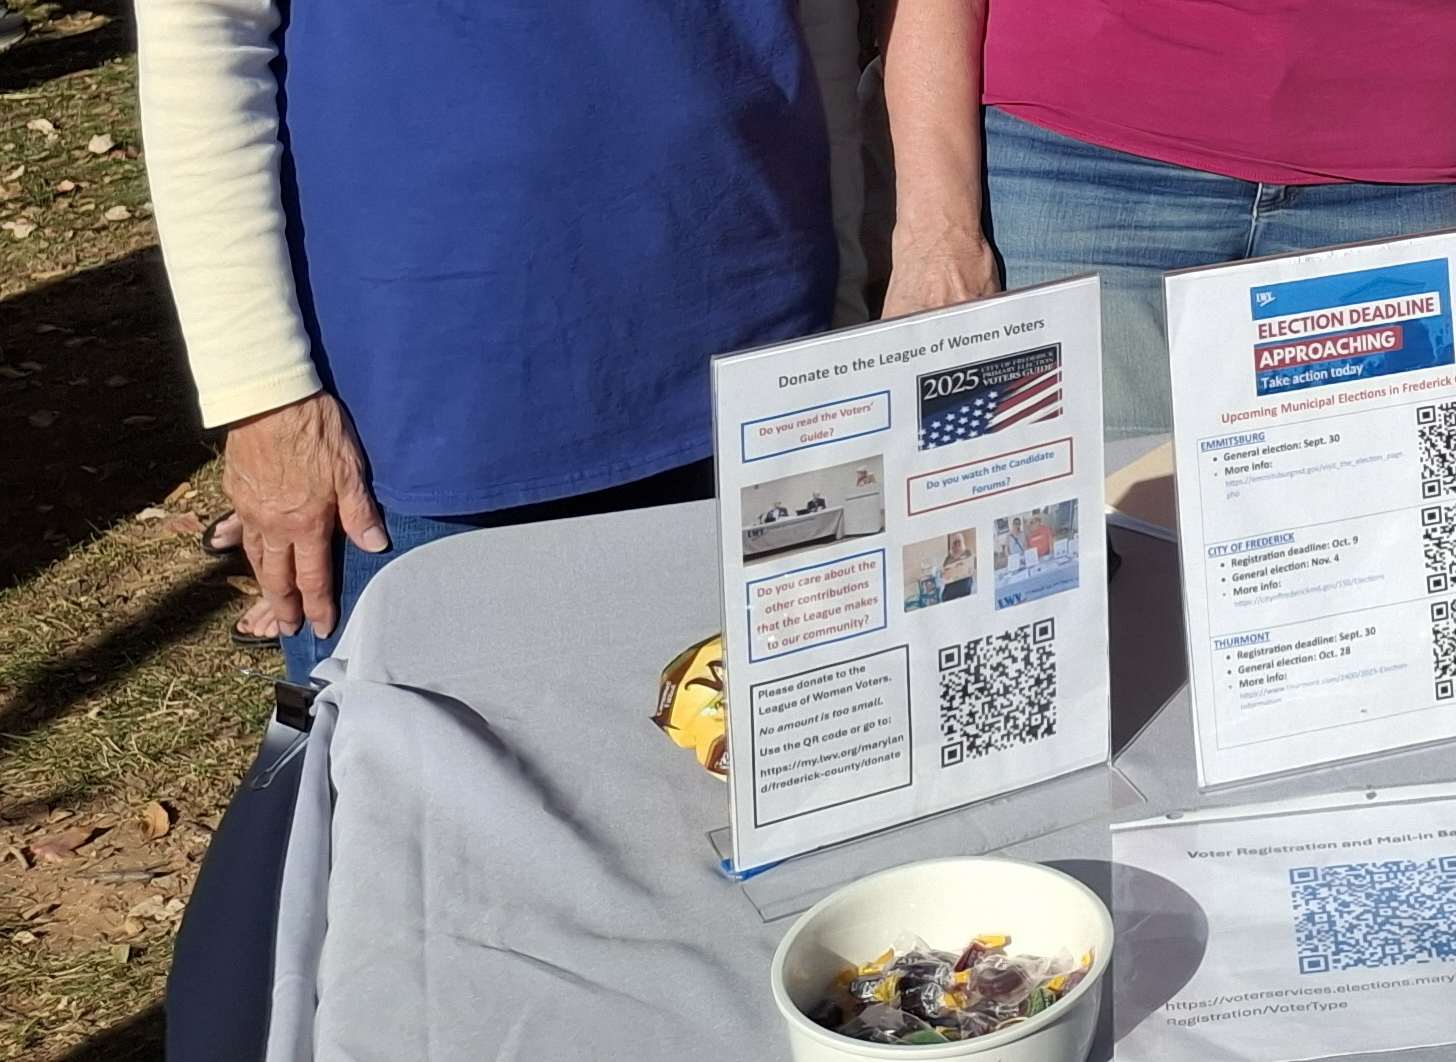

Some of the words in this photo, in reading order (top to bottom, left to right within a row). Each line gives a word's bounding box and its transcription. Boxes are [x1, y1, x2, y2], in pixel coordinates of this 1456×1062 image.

[1257, 311, 1343, 339] ELECTION
[1348, 296, 1434, 324] DEADLINE
[778, 368, 829, 388] Donate
[833, 364, 847, 375] to
[852, 357, 874, 371] the
[879, 346, 926, 365] League
[930, 338, 944, 353] of
[947, 330, 999, 348] Women
[1003, 319, 1044, 336] Voters
[1259, 331, 1395, 367] APPROACHING
[923, 369, 979, 400] 2025
[1260, 375, 1290, 388] Take
[1292, 369, 1328, 384] action
[1330, 364, 1363, 377] today
[1221, 406, 1277, 424] Upcoming
[1280, 394, 1334, 413] Municipal
[1338, 388, 1386, 403] Elections
[1389, 385, 1399, 394] in
[1402, 376, 1451, 392] Frederick
[759, 427, 773, 436] Do
[775, 422, 793, 434] you
[796, 414, 818, 427] read
[820, 412, 837, 421] the
[799, 427, 836, 442] Guide?
[1200, 431, 1264, 451] EMMITSBURG
[1223, 447, 1259, 461] General
[1261, 442, 1301, 454] election:
[1303, 437, 1326, 448] Sept.
[1328, 433, 1340, 443] 30
[1207, 545, 1227, 556] CITY
[1230, 541, 1242, 552] OF
[1245, 532, 1294, 550] FREDERICK
[1213, 631, 1269, 648] THURMONT
[1186, 850, 1232, 858] Voter
[1236, 842, 1337, 855] Registration
[1341, 838, 1372, 847] and
[1377, 832, 1433, 844] Mail-in
